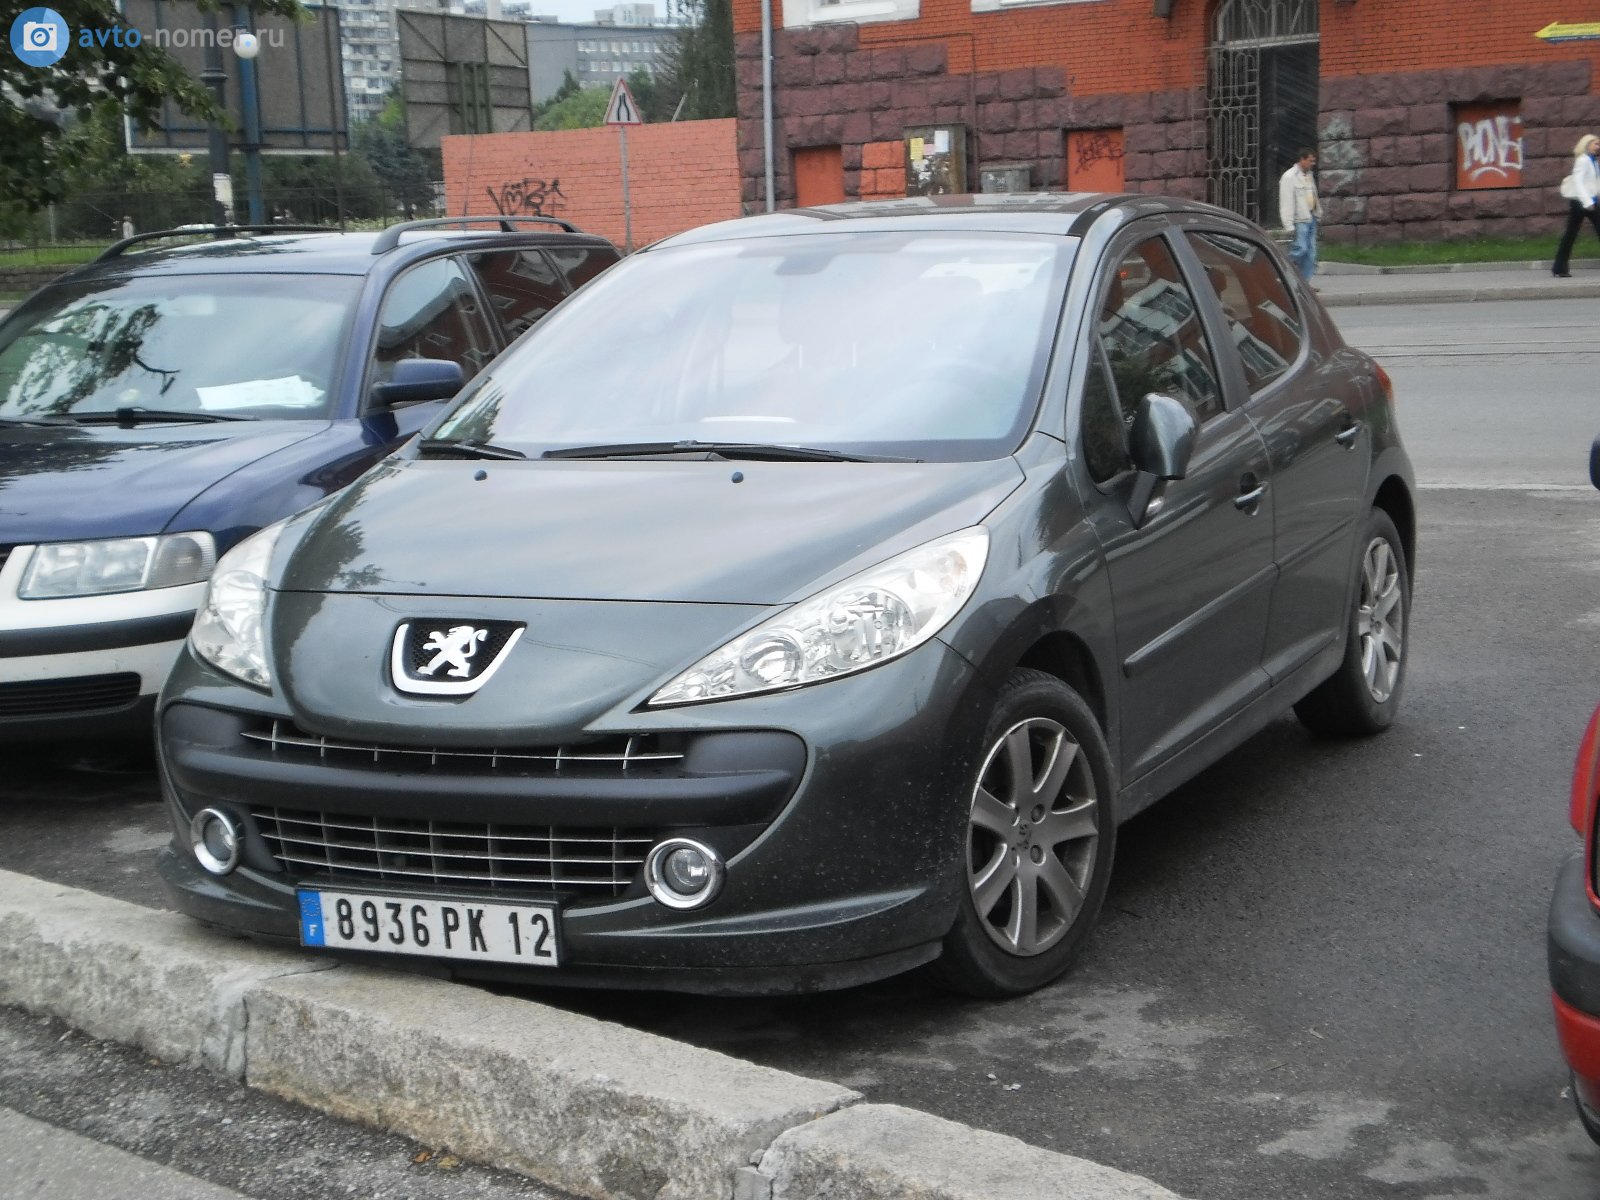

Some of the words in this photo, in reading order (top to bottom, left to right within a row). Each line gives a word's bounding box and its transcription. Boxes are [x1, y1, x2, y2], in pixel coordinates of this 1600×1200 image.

[308, 924, 318, 937] F
[335, 898, 431, 948] 8936
[441, 906, 489, 953] PK
[508, 911, 552, 958] 12
